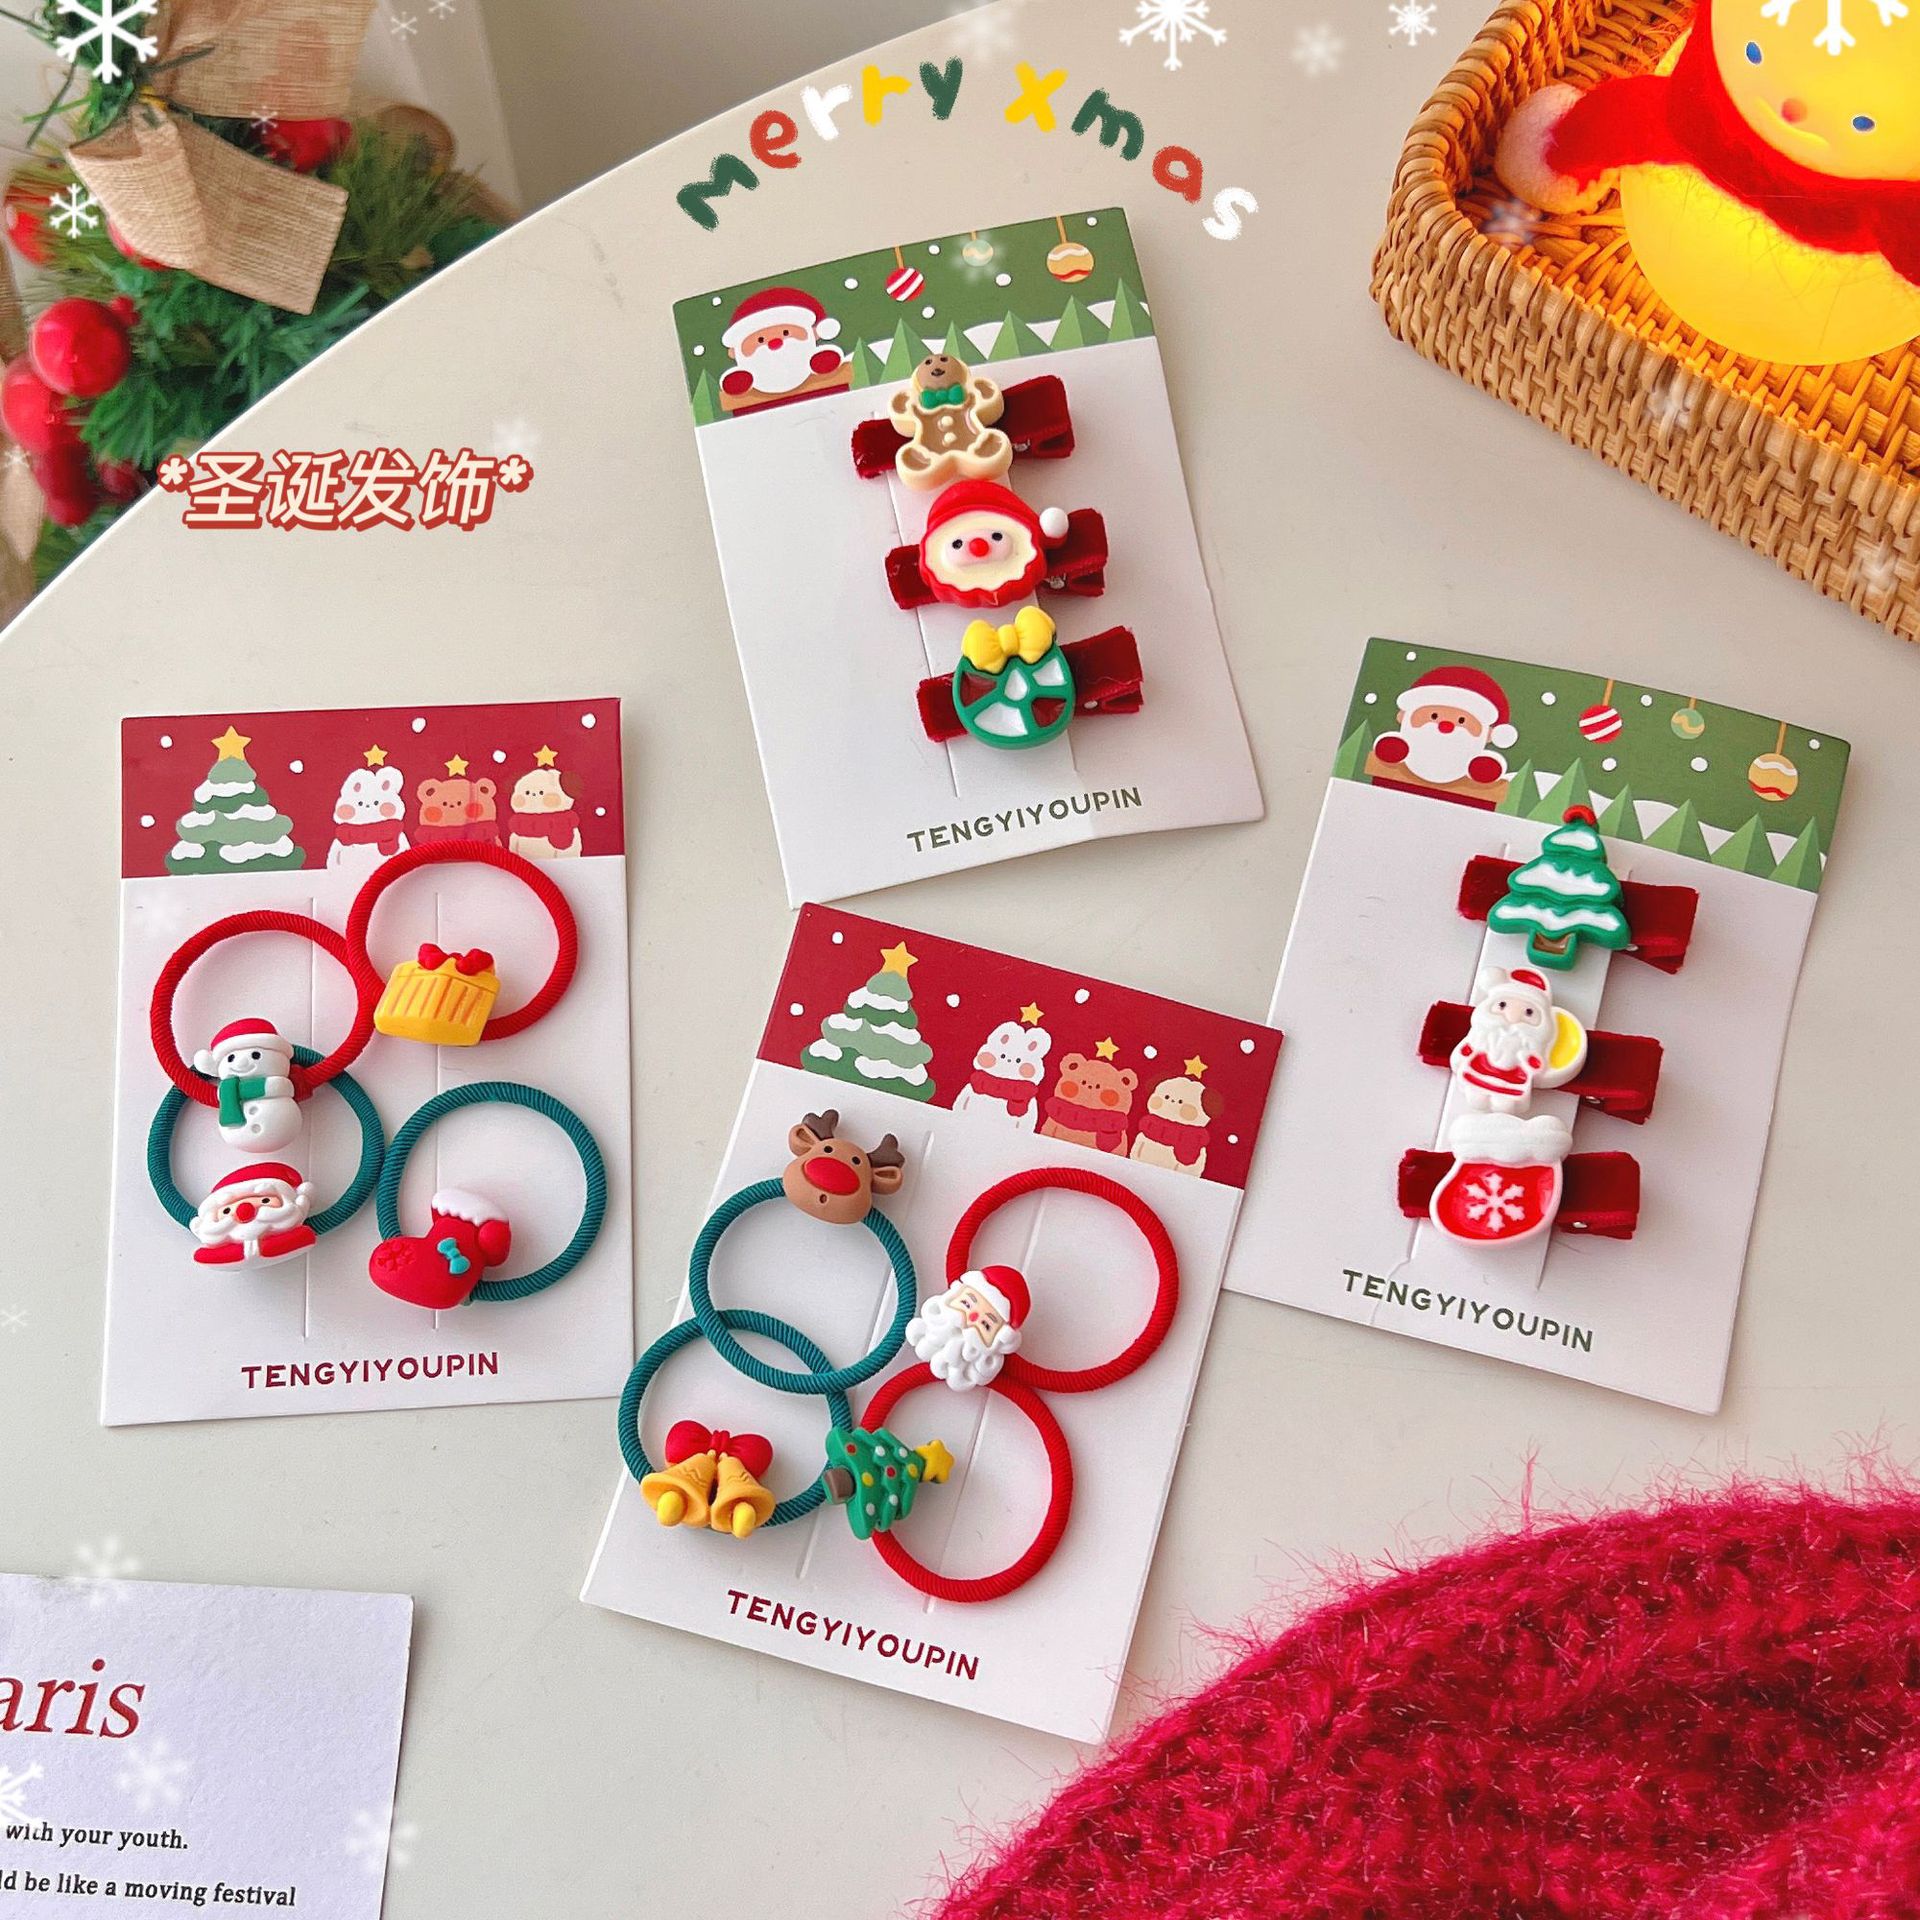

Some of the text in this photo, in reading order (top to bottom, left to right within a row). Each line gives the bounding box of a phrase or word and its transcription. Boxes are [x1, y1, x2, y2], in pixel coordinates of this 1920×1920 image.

[906, 786, 1143, 852] TENGYIYOUPIN
[1342, 1268, 1594, 1353] TENGYIYOUPIN
[241, 1351, 499, 1389] TENGYIYOUPIN
[727, 1589, 979, 1681] TENGYIYOUPIN
[59, 1827, 113, 1848] your
[117, 1829, 188, 1851] youth.
[24, 1870, 51, 1892] be
[56, 1873, 98, 1895] like
[104, 1881, 117, 1896] a
[124, 1881, 207, 1907] moving
[213, 1882, 296, 1906] festival
